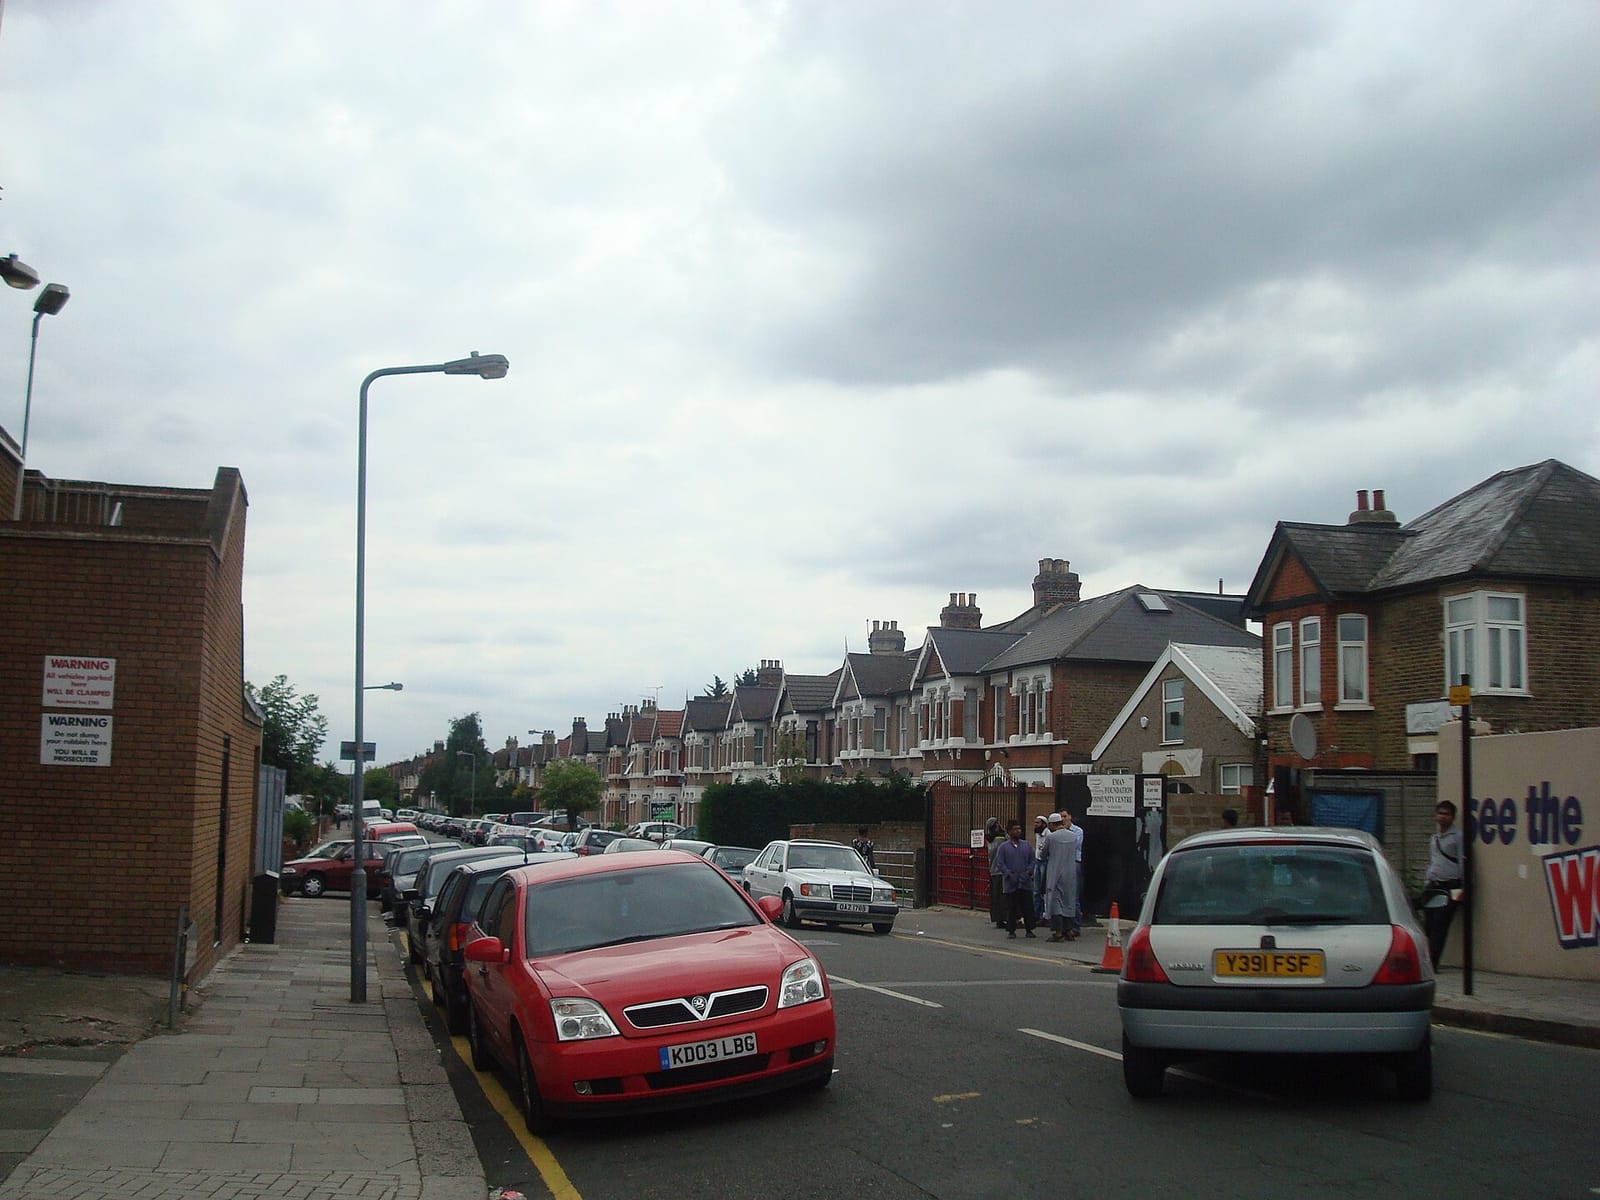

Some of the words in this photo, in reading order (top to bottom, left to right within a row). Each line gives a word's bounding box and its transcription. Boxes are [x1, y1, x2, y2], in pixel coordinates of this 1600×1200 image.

[51, 659, 110, 671] WARNING
[48, 716, 108, 728] WARNING
[46, 739, 60, 747] your
[53, 755, 98, 763] PROSECUTED
[1104, 786, 1133, 794] FOUNDATION
[1115, 796, 1132, 804] CENTRE
[1470, 797, 1517, 845] see
[1526, 781, 1583, 845] the
[1542, 845, 1600, 950] W
[1226, 954, 1268, 973] Y391
[1273, 955, 1311, 974] FSF
[671, 1042, 718, 1065] KD03
[721, 1036, 755, 1057] LBG
